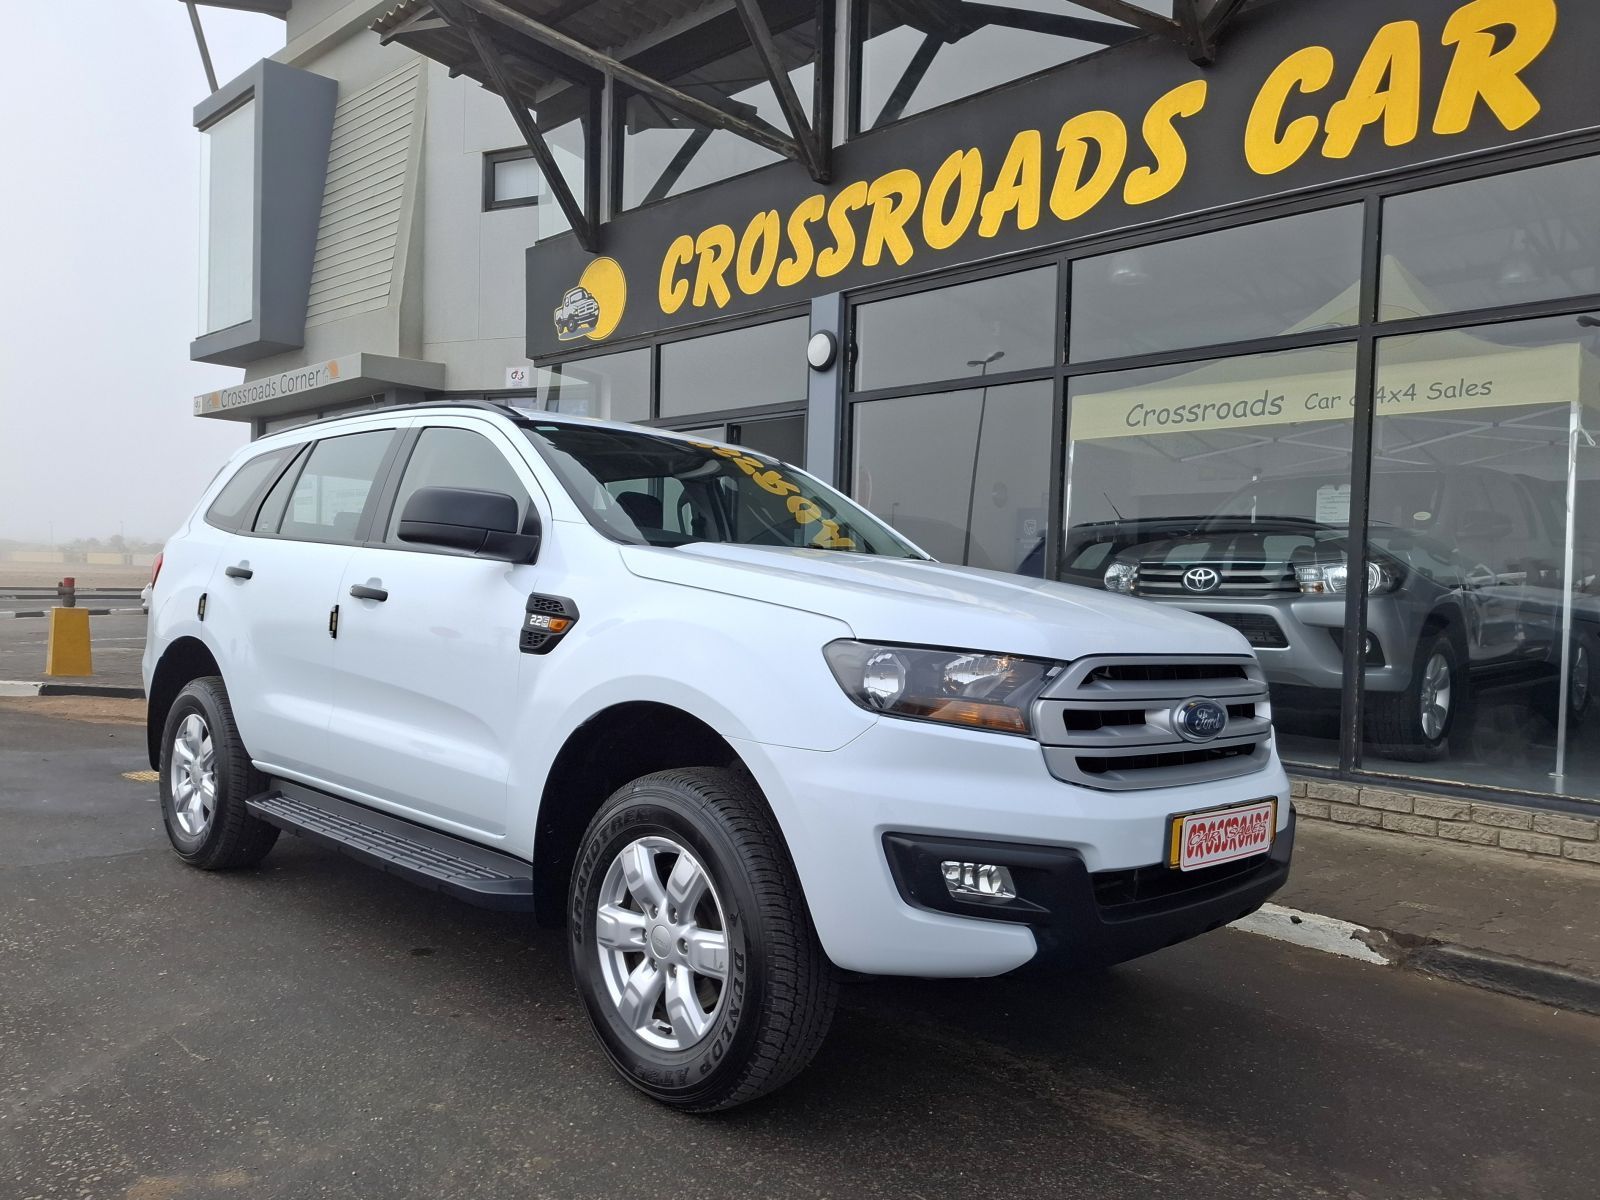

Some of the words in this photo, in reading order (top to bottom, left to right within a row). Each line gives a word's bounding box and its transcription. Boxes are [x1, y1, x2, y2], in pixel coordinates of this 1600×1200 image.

[658, 79, 1207, 314] CROSSROADS
[1244, 0, 1556, 175] CAR
[221, 378, 276, 408] Crossroads
[280, 369, 321, 394] Corner
[1125, 390, 1284, 427] Crossroads
[1304, 393, 1341, 410] Car
[1375, 383, 1417, 405] 4x4
[1426, 378, 1493, 399] Sales
[1195, 708, 1222, 731] Ford
[1187, 810, 1270, 859] CROSSROADS
[1228, 820, 1268, 839] SALES
[700, 947, 746, 1076] DUNLOP
